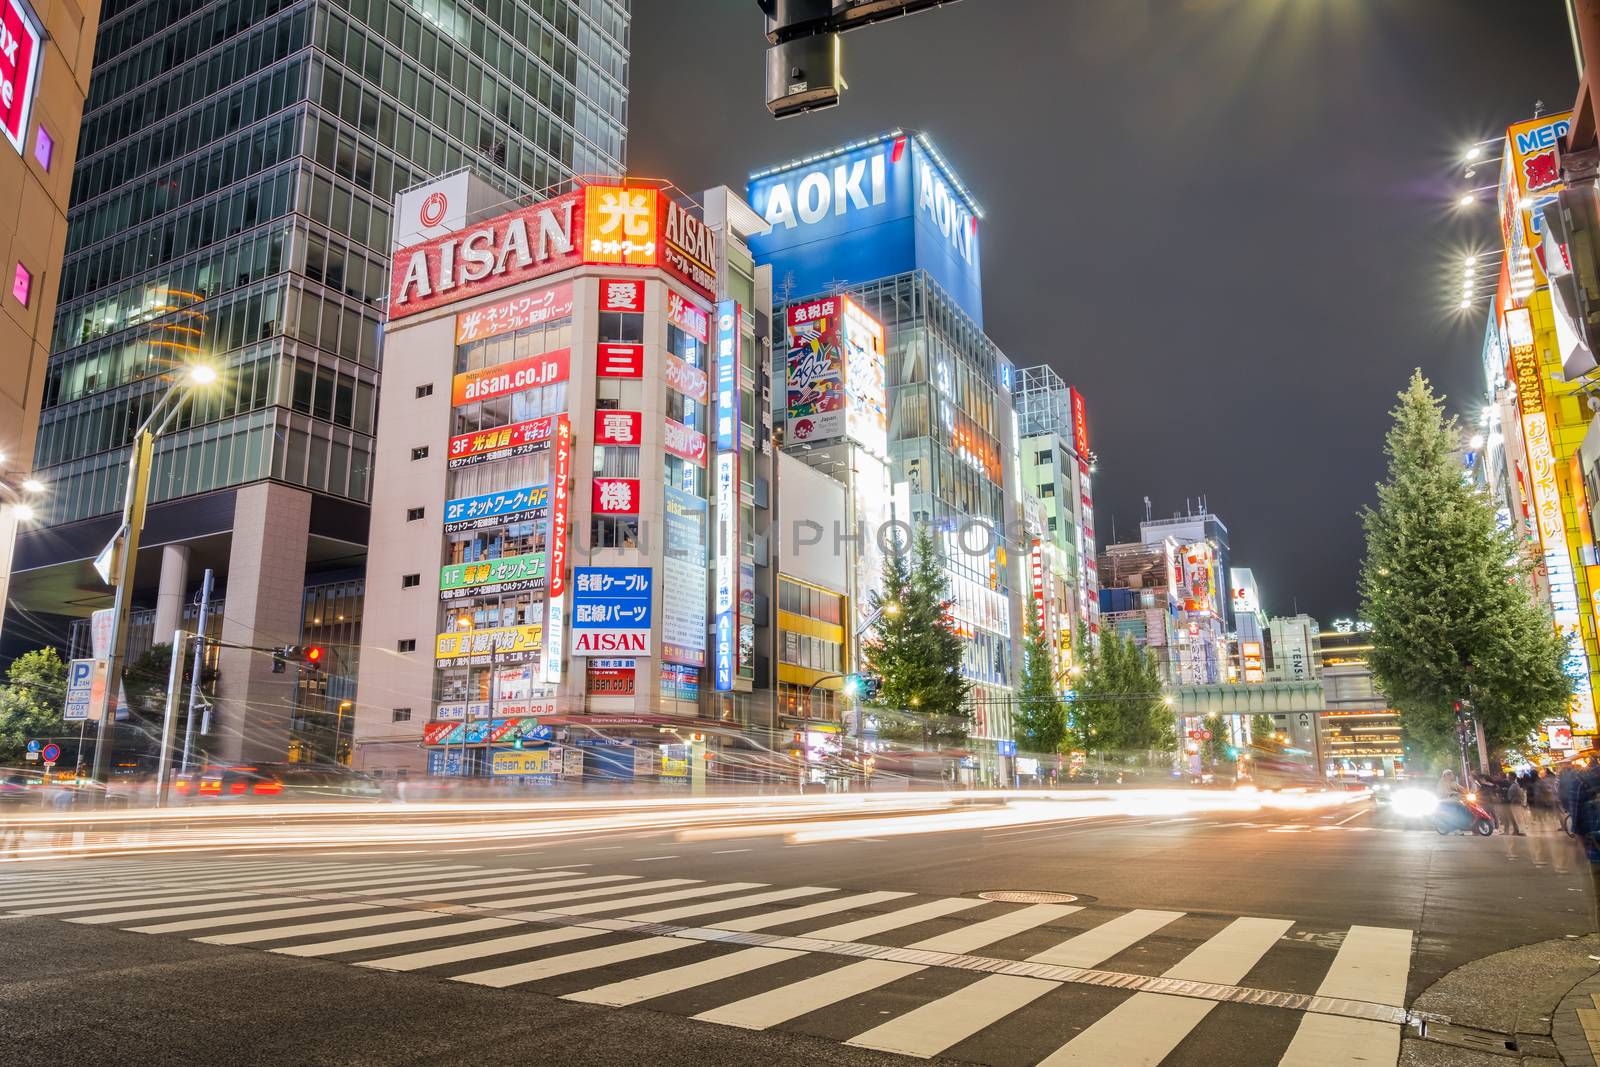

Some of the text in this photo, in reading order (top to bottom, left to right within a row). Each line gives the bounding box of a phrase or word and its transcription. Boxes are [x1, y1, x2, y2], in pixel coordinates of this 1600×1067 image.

[761, 154, 887, 236] AOKI
[599, 191, 649, 236] 光
[920, 160, 972, 266] AOKI
[666, 200, 716, 270] AISAN
[396, 200, 576, 304] AISAN
[590, 239, 656, 256] ネットワーク
[795, 301, 834, 323] 免税店
[465, 361, 558, 399] aisan.co.jp
[452, 438, 469, 454] 3F
[448, 504, 465, 519] 2F
[444, 569, 460, 584] 1F
[577, 573, 649, 592] 各種ケーブル
[576, 604, 647, 623] 配線パーツ
[576, 633, 646, 651] AISAN
[719, 615, 731, 684] AISAN
[74, 664, 90, 687] P
